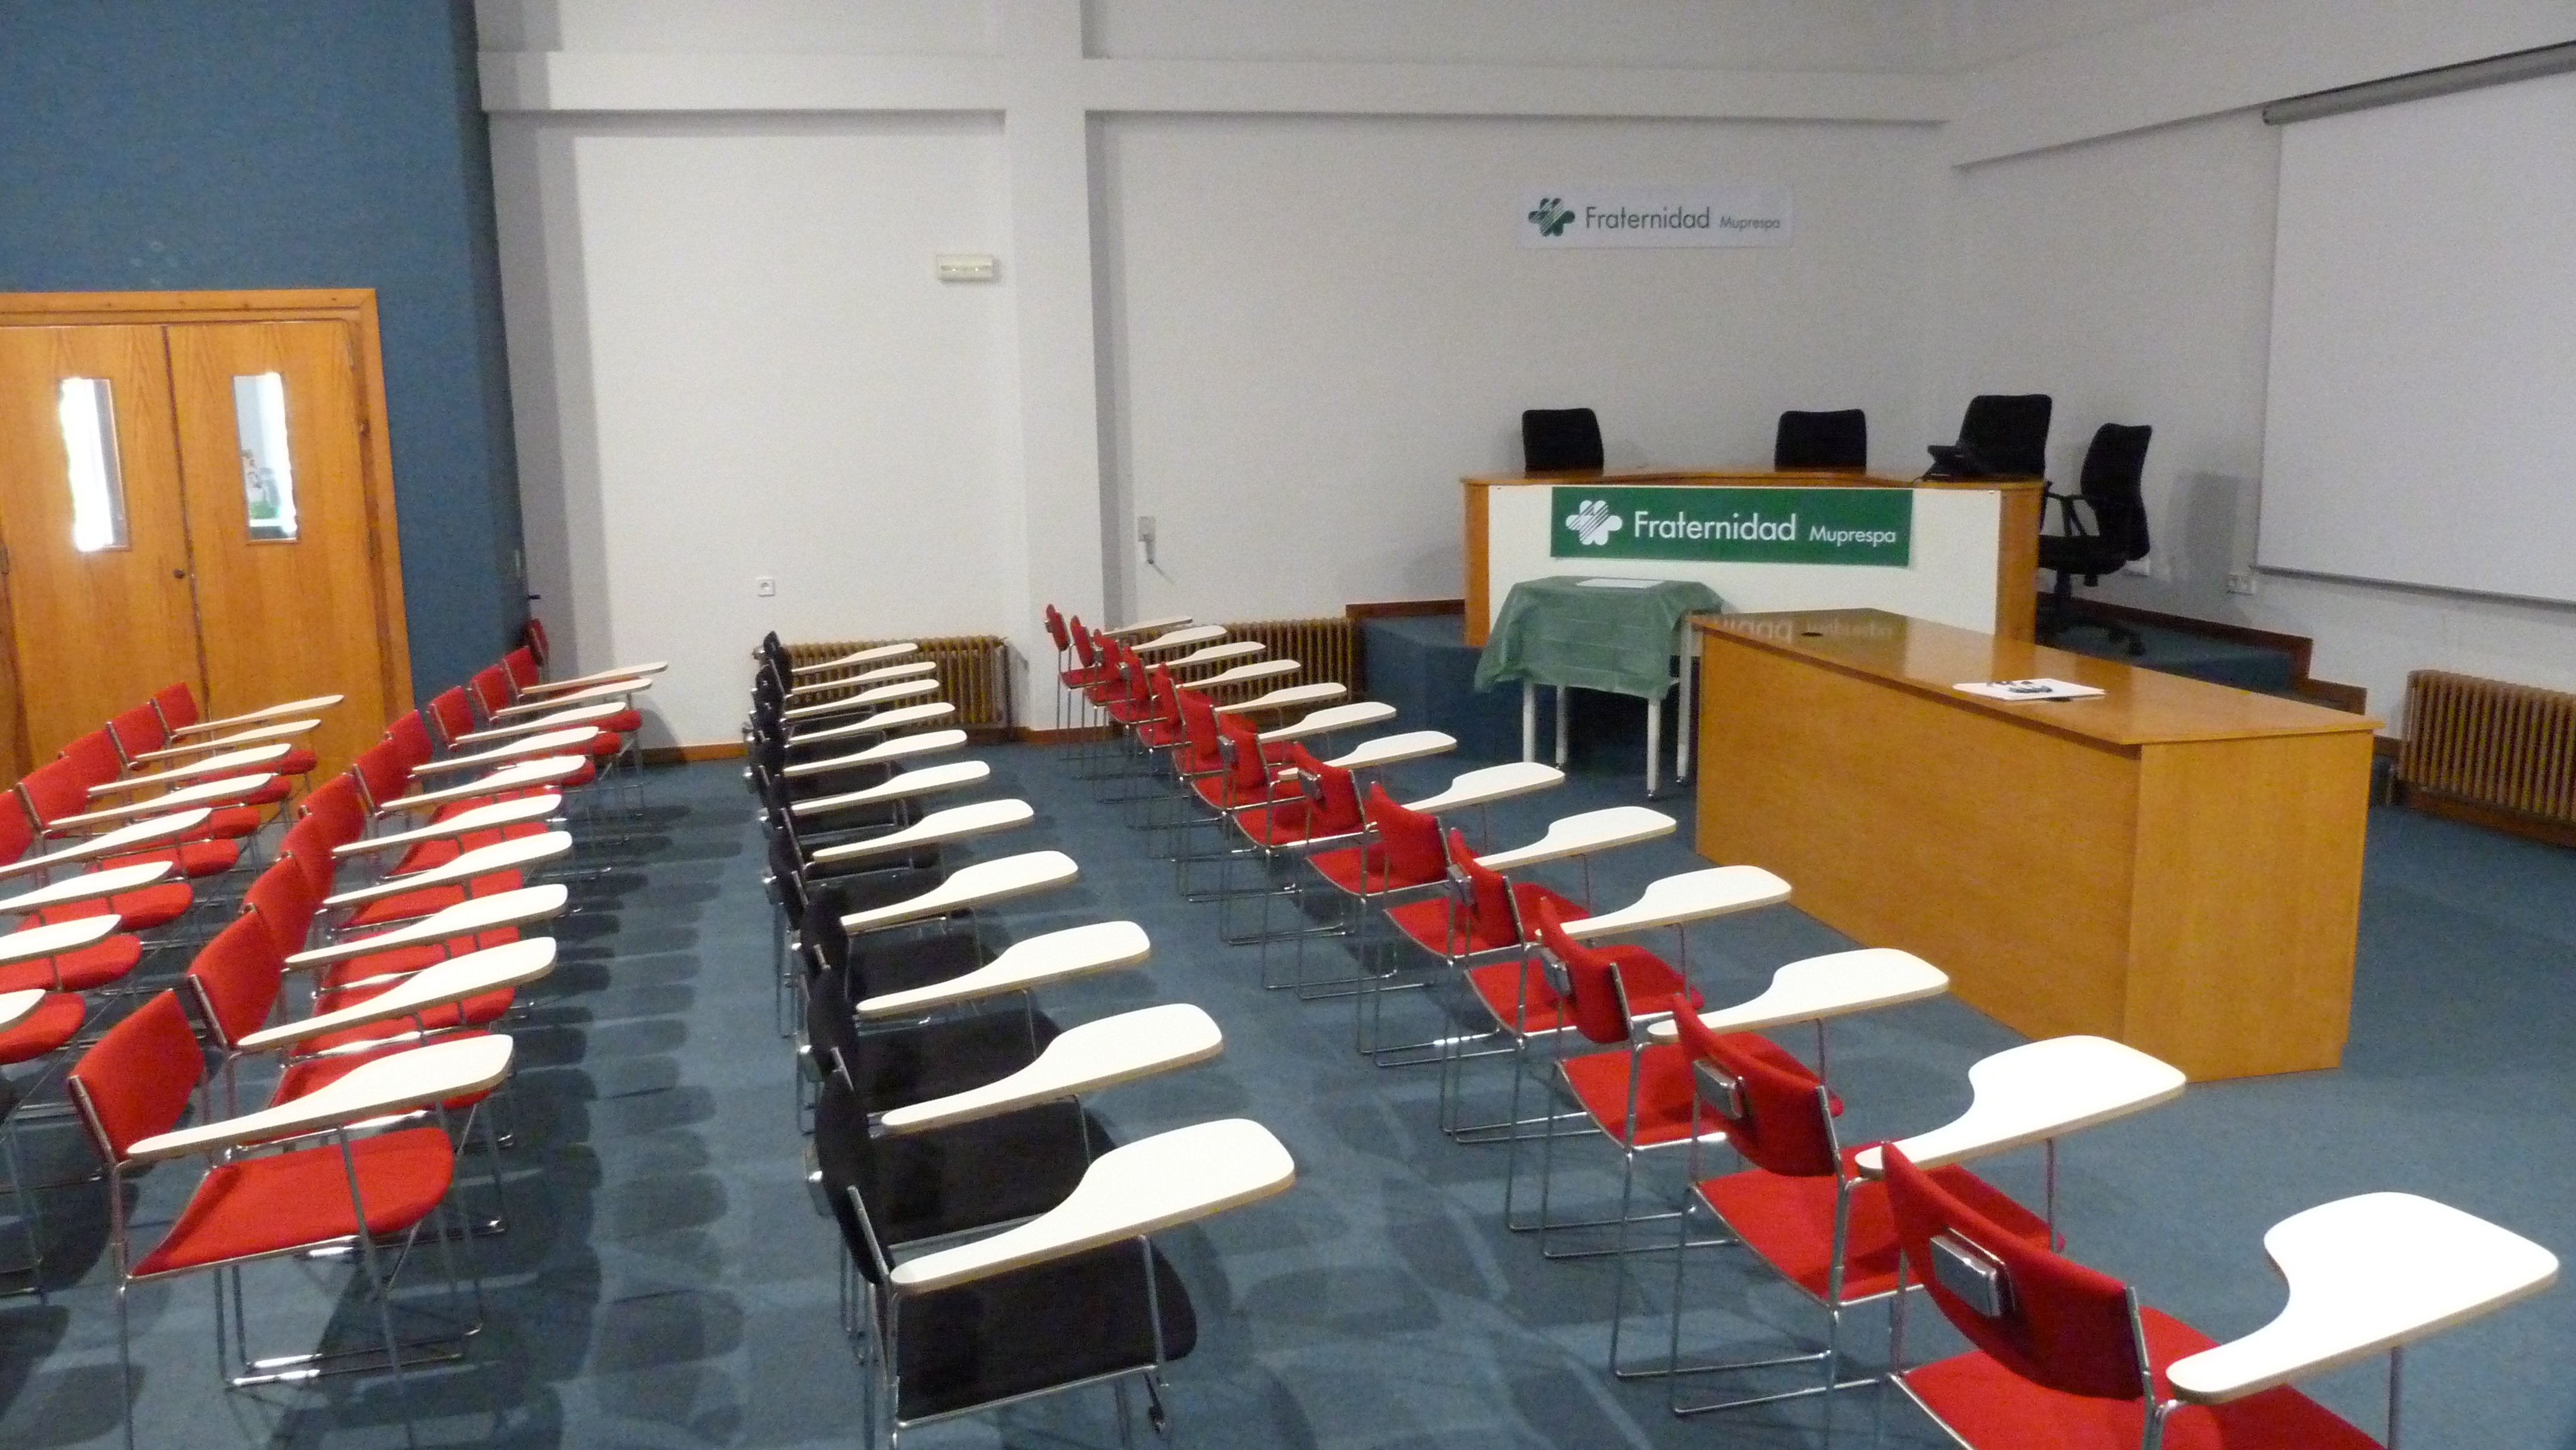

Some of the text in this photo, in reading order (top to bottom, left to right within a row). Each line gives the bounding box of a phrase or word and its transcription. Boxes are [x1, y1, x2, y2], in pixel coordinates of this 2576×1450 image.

[1586, 206, 1781, 231] Fraternidad Muprespa
[1634, 510, 1896, 548] Fraternidad Muprespa
